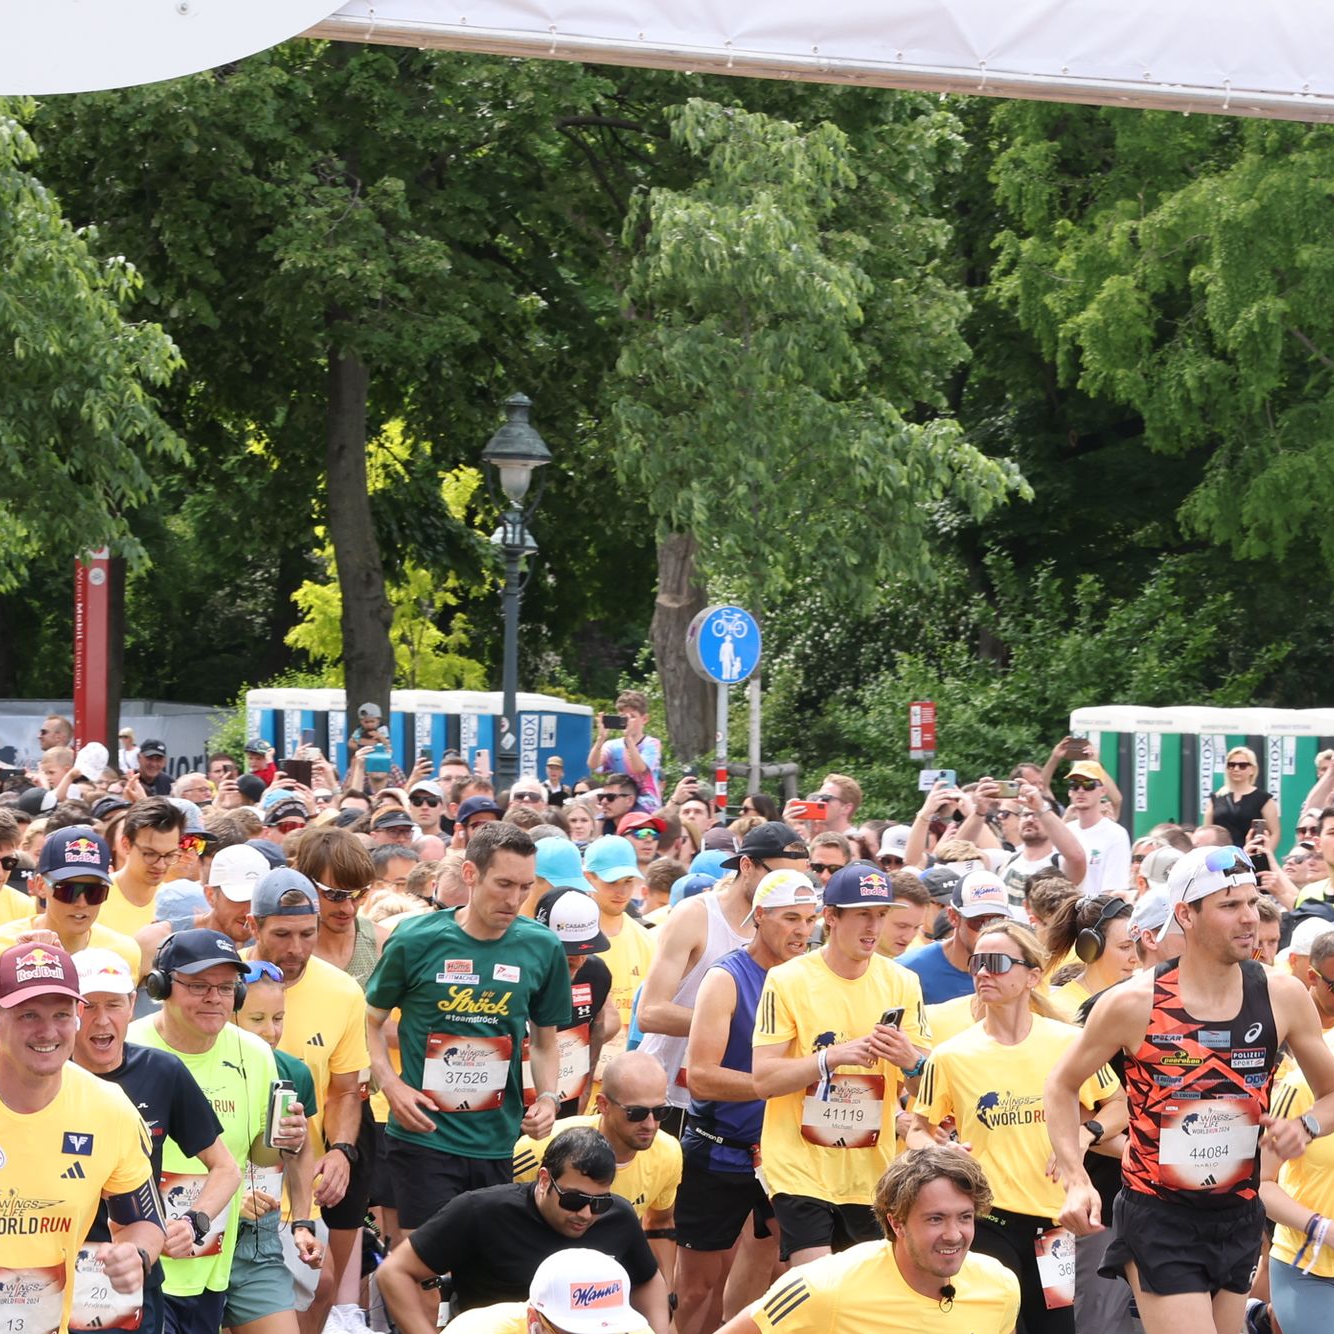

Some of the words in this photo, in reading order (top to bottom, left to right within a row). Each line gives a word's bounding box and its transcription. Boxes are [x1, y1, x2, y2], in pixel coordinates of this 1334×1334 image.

[523, 717, 537, 777] IPIBOX
[860, 886, 876, 896] Red
[16, 965, 43, 982] Red
[43, 964, 65, 982] Bull
[437, 985, 513, 1016] Ströck
[444, 1014, 500, 1025] #teamströck
[1152, 1033, 1182, 1042] POLAR
[445, 1071, 489, 1084] 37526
[214, 1099, 236, 1113] RUN
[822, 1107, 864, 1123] 41119
[989, 1111, 1033, 1127] WORLD
[1200, 1113, 1229, 1122] WINGS
[1204, 1120, 1220, 1128] LIFE
[1189, 1144, 1229, 1160] 44084
[2, 1208, 26, 1217] LIFE
[39, 1216, 72, 1235] RUN
[3, 1281, 40, 1293] WINGS
[90, 1286, 108, 1301] 20
[7, 1290, 29, 1299] LIFE
[26, 1296, 40, 1304] 2024
[572, 1282, 622, 1307] Manner
[6, 1318, 25, 1333] 13
